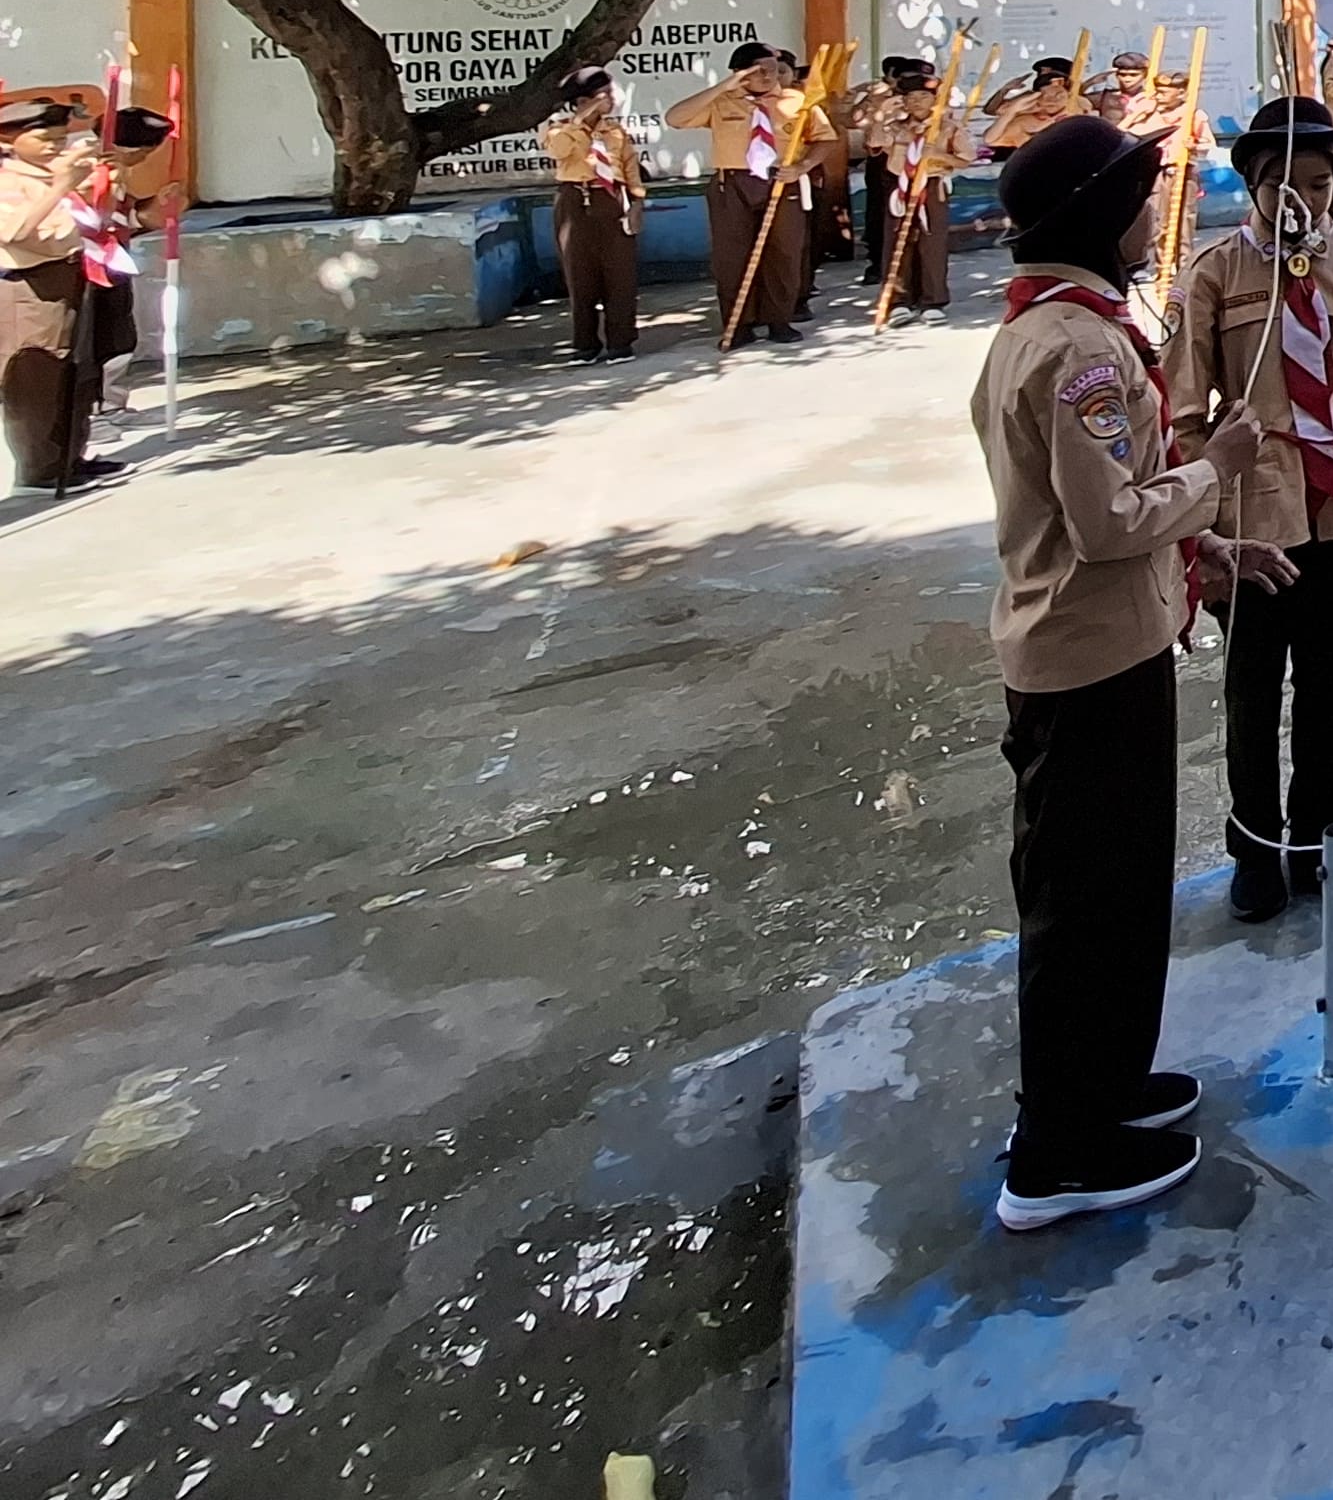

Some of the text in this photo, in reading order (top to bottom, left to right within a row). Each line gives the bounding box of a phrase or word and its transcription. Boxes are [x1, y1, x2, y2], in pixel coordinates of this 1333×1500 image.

[492, 9, 547, 19] JANTUNG
[471, 28, 552, 51] SEHAT
[651, 22, 758, 46] ABEPURA
[450, 58, 516, 82] GAYA
